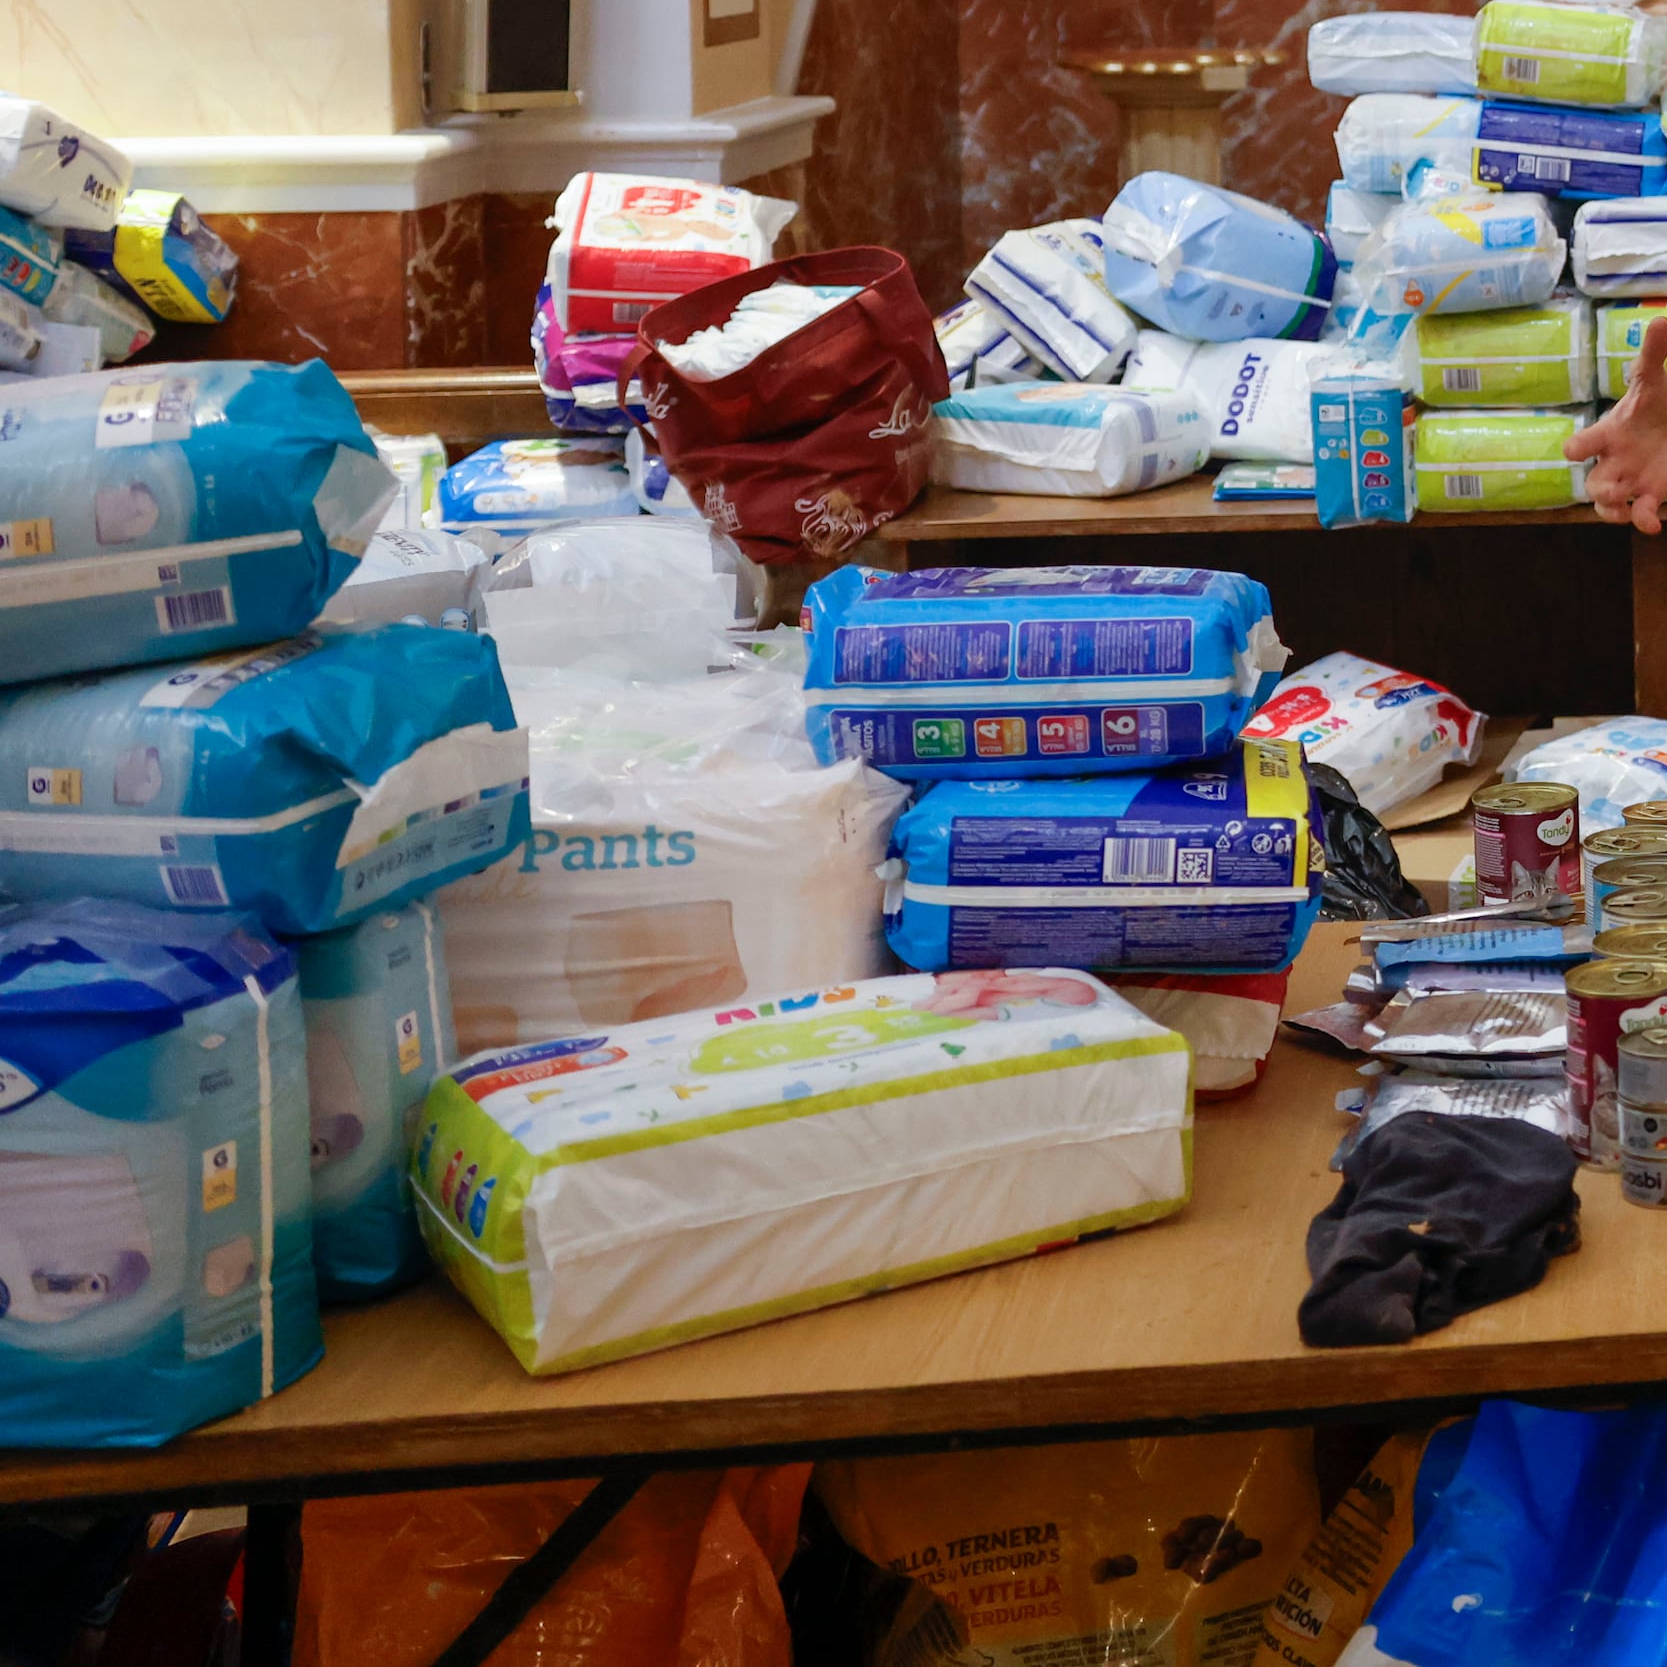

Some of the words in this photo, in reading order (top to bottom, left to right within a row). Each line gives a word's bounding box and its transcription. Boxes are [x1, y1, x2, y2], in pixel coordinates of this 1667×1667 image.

[1220, 352, 1261, 436] DODOT
[917, 725, 940, 740] 3
[978, 722, 1001, 740] 4
[1041, 722, 1065, 737] 5
[1106, 715, 1136, 734] 6
[1541, 824, 1570, 840] Tandy
[518, 824, 696, 873] Pants
[945, 1521, 1060, 1560] TERNERA
[959, 1547, 1061, 1577] VERDURAS
[968, 1575, 1062, 1606] VITELA
